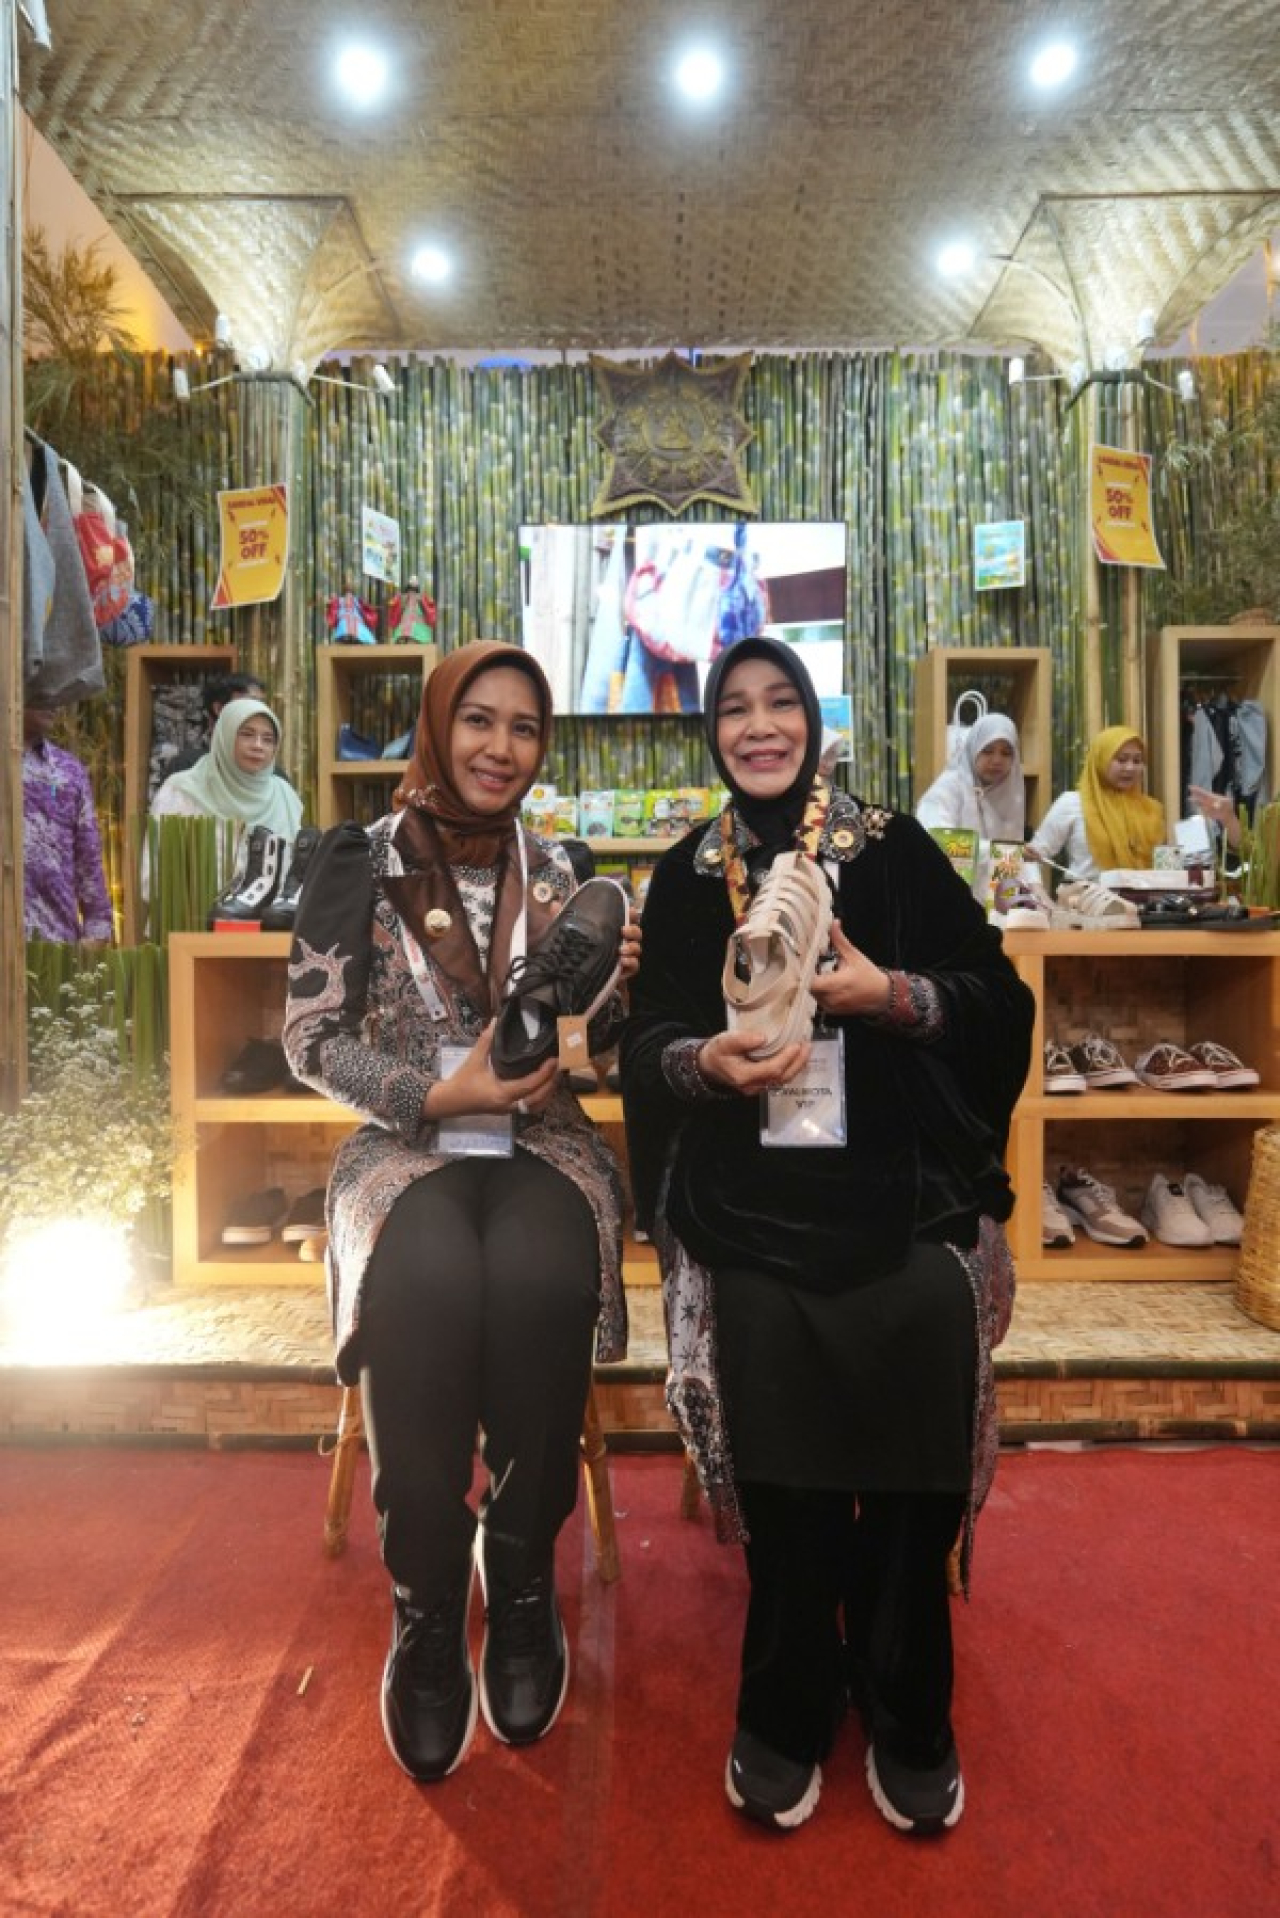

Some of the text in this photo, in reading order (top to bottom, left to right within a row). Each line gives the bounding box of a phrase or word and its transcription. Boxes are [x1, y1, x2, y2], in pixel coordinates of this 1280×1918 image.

[1106, 488, 1134, 504] 50%
[1109, 505, 1132, 520] OFF
[240, 529, 270, 544] 50%
[240, 543, 267, 559] OFF
